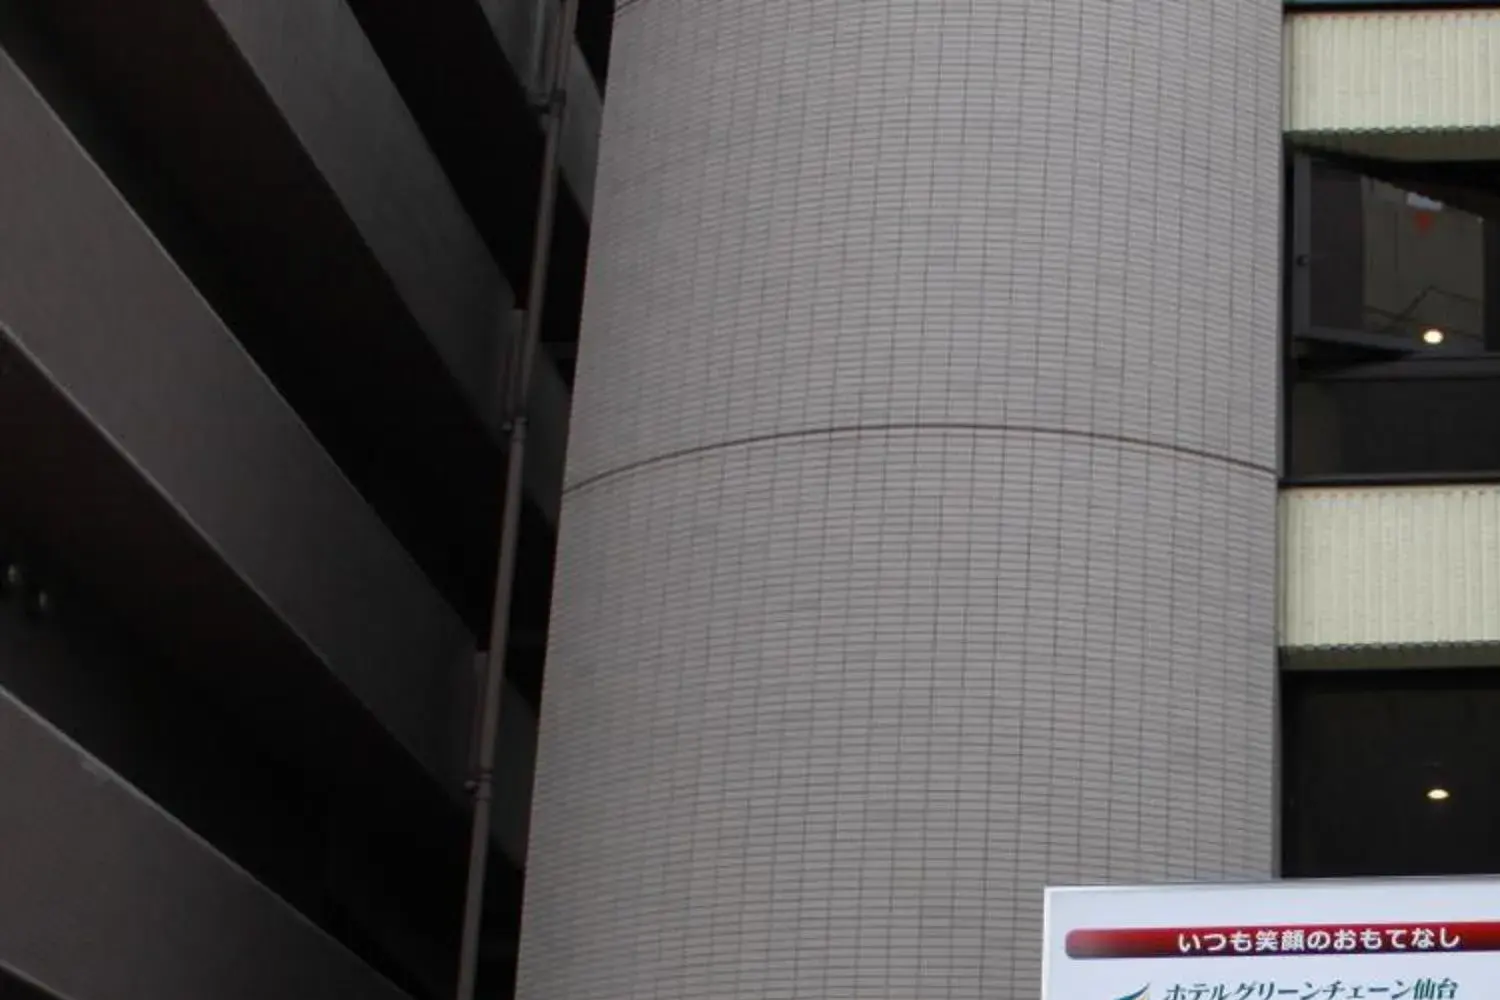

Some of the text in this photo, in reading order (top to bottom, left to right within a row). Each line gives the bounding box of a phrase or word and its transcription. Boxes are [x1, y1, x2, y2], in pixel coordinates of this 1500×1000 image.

[1177, 927, 1461, 953] いつも笑顔のおもてなし
